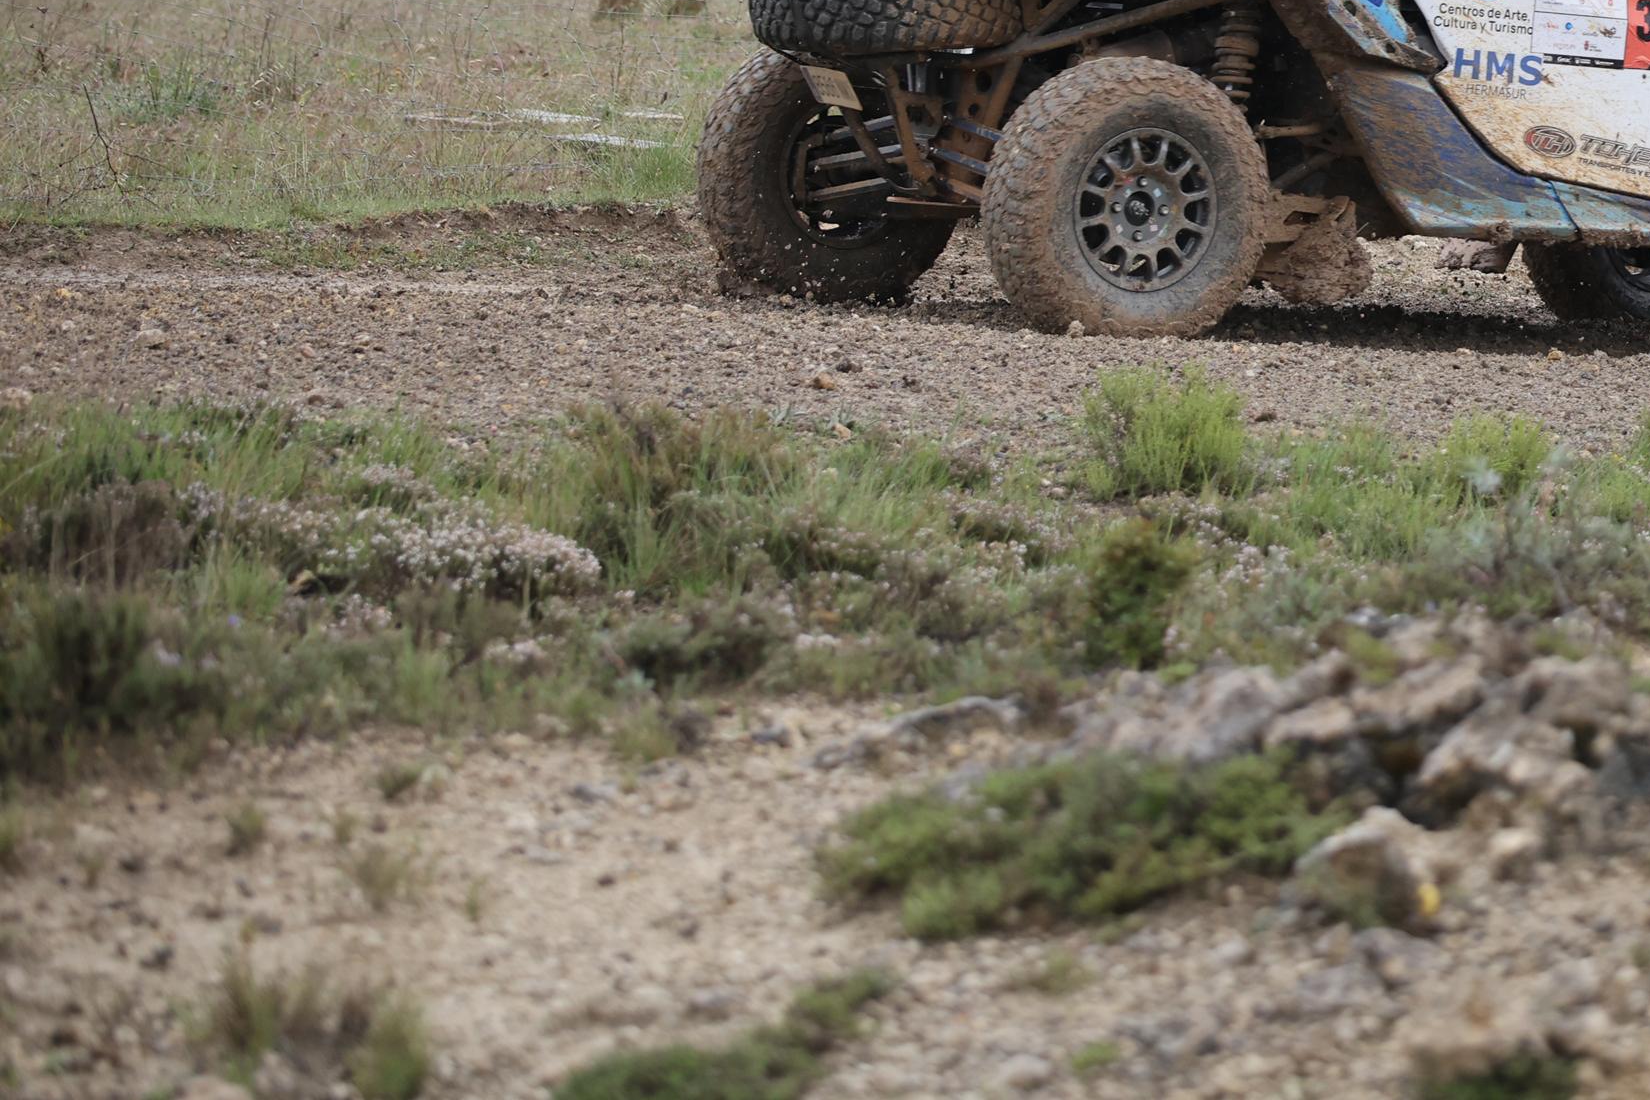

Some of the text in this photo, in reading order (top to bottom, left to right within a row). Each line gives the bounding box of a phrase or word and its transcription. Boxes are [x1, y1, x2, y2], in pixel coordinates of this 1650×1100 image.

[1439, 3, 1530, 23] Centros de Arte,
[1433, 16, 1533, 35] Cultura y Turismo
[1453, 47, 1542, 86] HMS
[1465, 83, 1527, 100] HERMASUR
